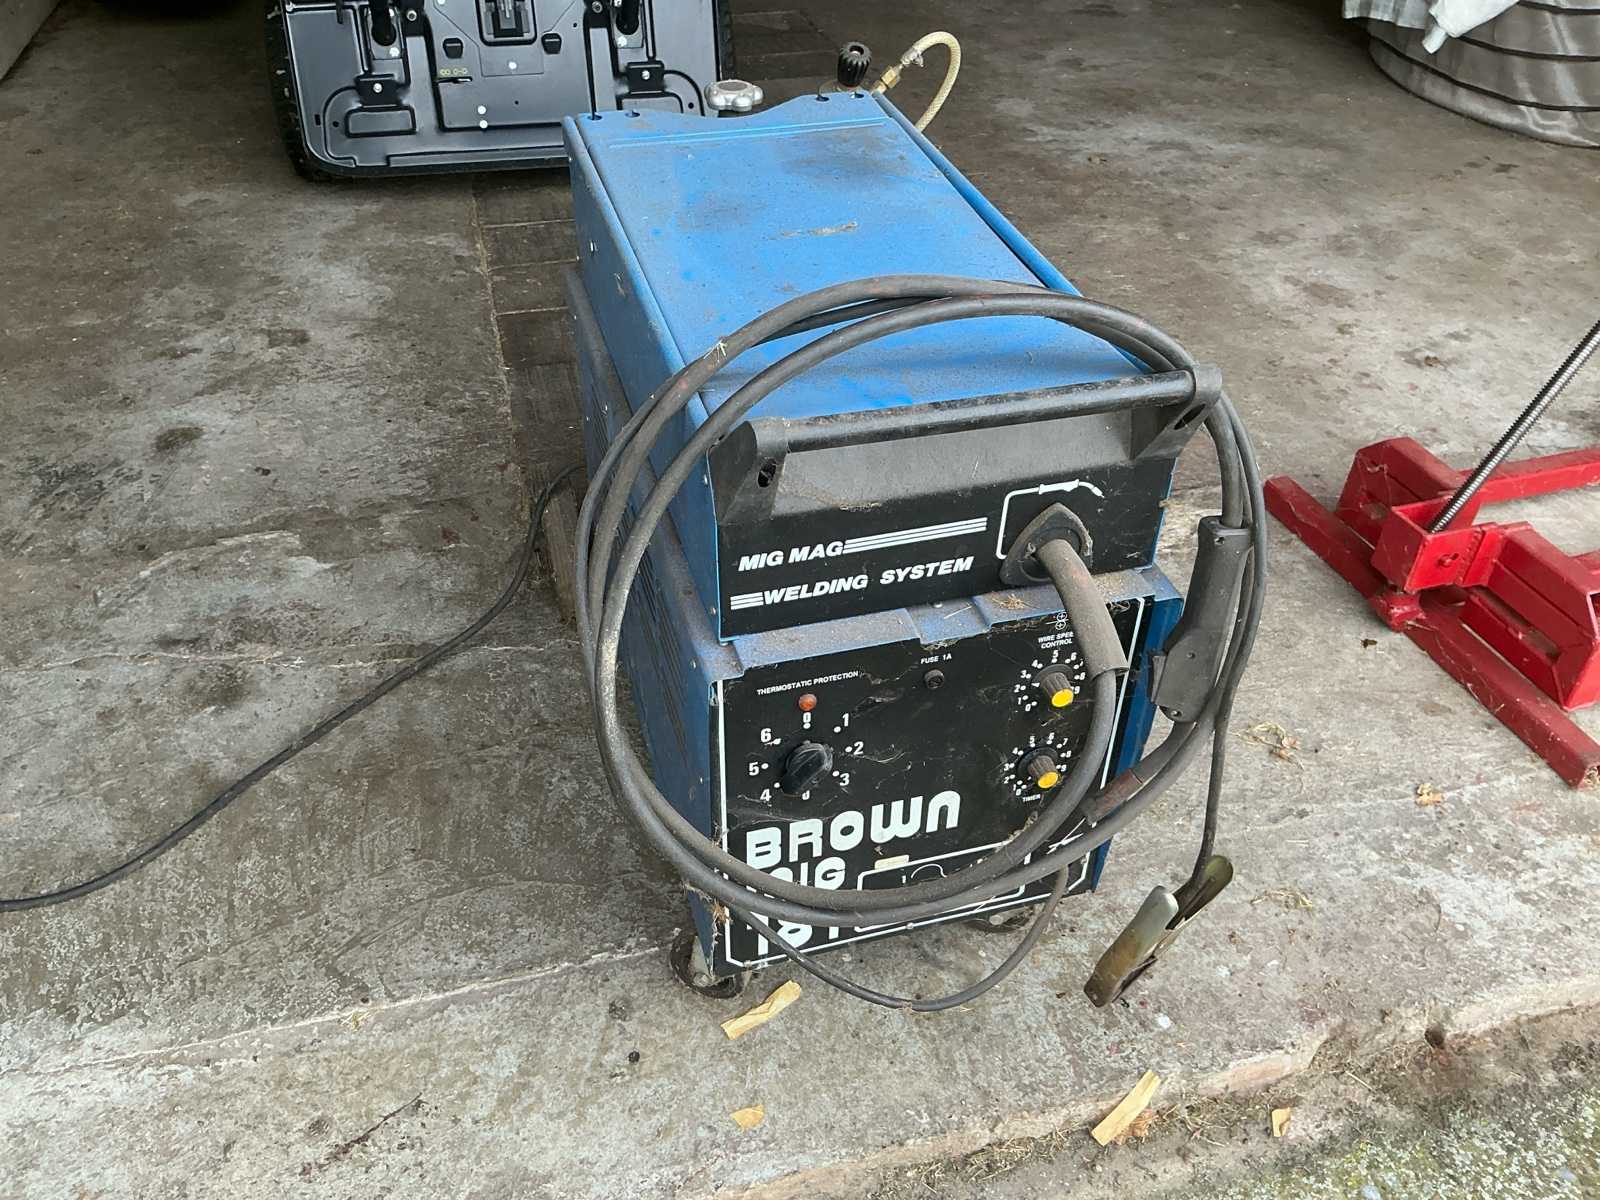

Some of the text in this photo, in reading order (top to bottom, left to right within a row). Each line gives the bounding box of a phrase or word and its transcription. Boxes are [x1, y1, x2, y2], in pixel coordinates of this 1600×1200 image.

[738, 541, 845, 571] MIG MAG
[763, 556, 974, 605] WELDING SYSTEM
[1038, 634, 1055, 643] WIRE
[1041, 638, 1073, 649] CONTROL
[920, 655, 939, 664] FUSE
[1053, 649, 1059, 658] 5
[757, 671, 859, 695] THERMOSTATIC PROTECTION
[803, 712, 812, 723] 0
[842, 713, 849, 726] 1
[760, 728, 772, 742] 6
[853, 741, 864, 755] 2
[749, 762, 760, 776] 5
[839, 773, 850, 787] 3
[760, 789, 771, 802] 4
[746, 790, 961, 870] BROWN
